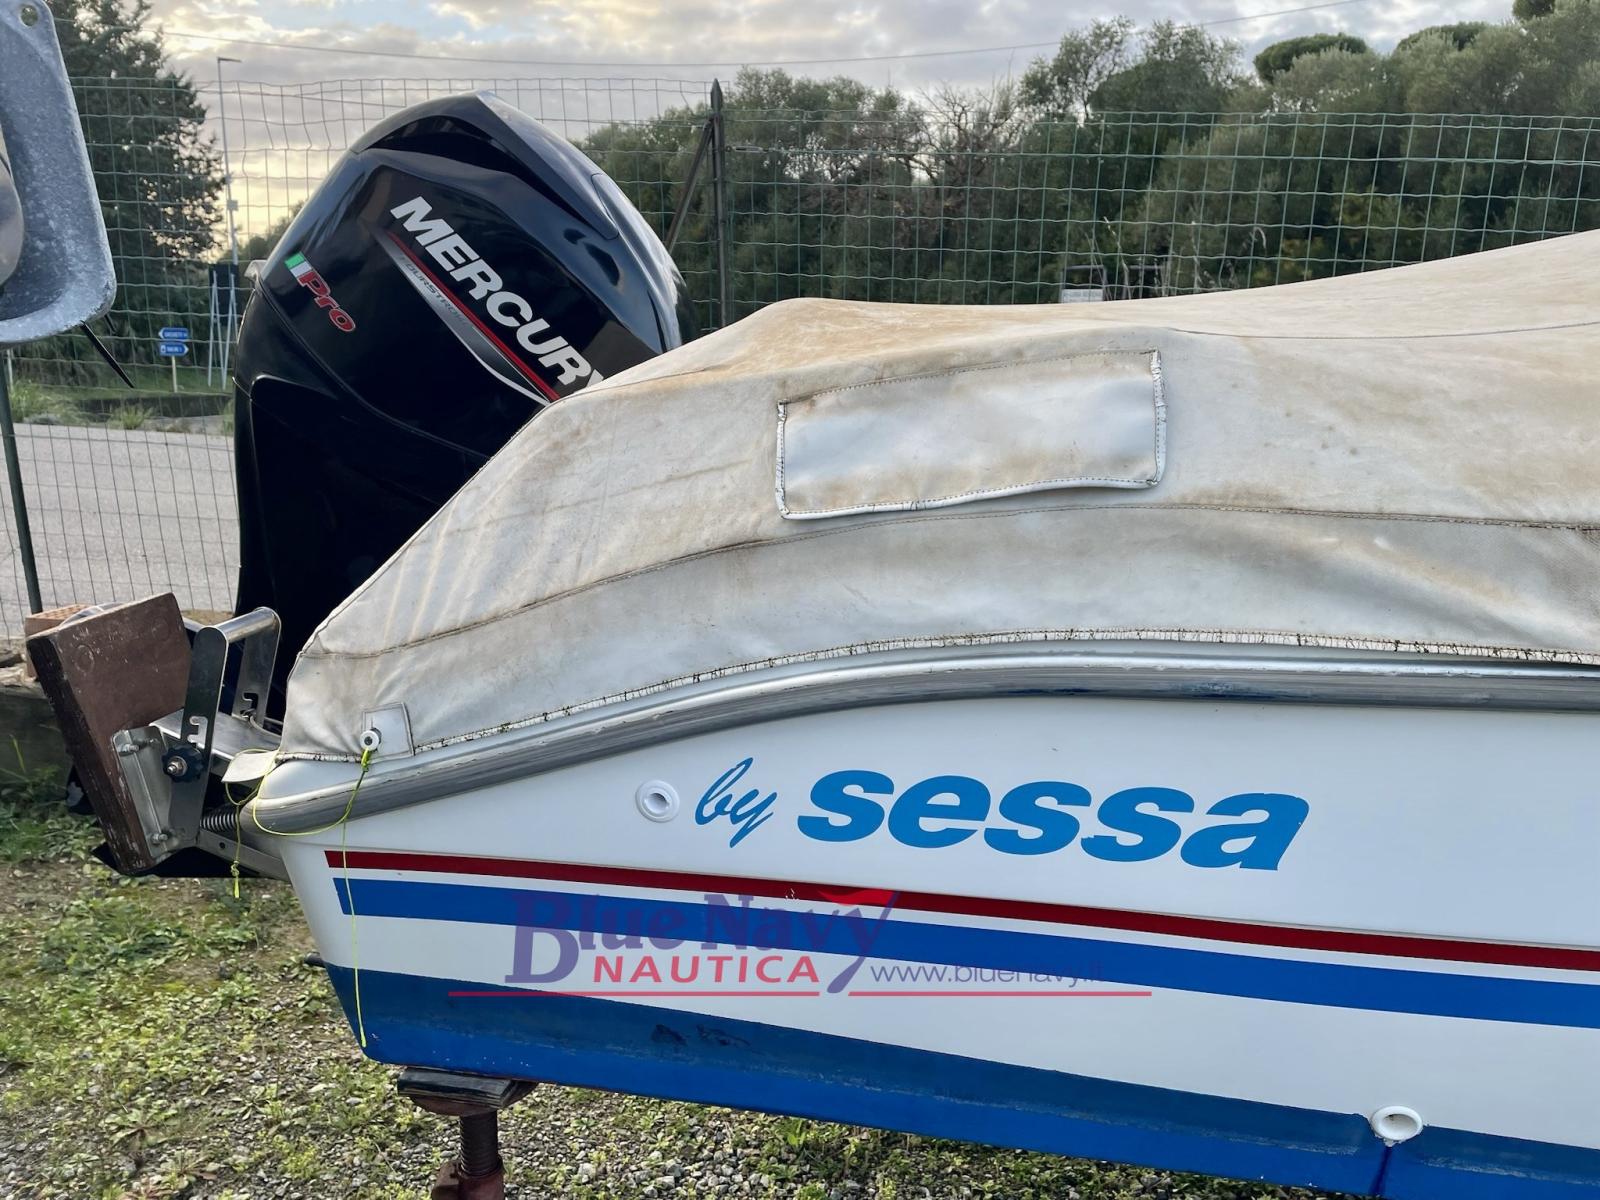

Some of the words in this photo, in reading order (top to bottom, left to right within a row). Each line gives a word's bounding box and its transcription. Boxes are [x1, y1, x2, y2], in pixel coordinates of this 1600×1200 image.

[296, 268, 356, 332] Pro
[694, 756, 778, 849] by
[797, 769, 1310, 871] sessa
